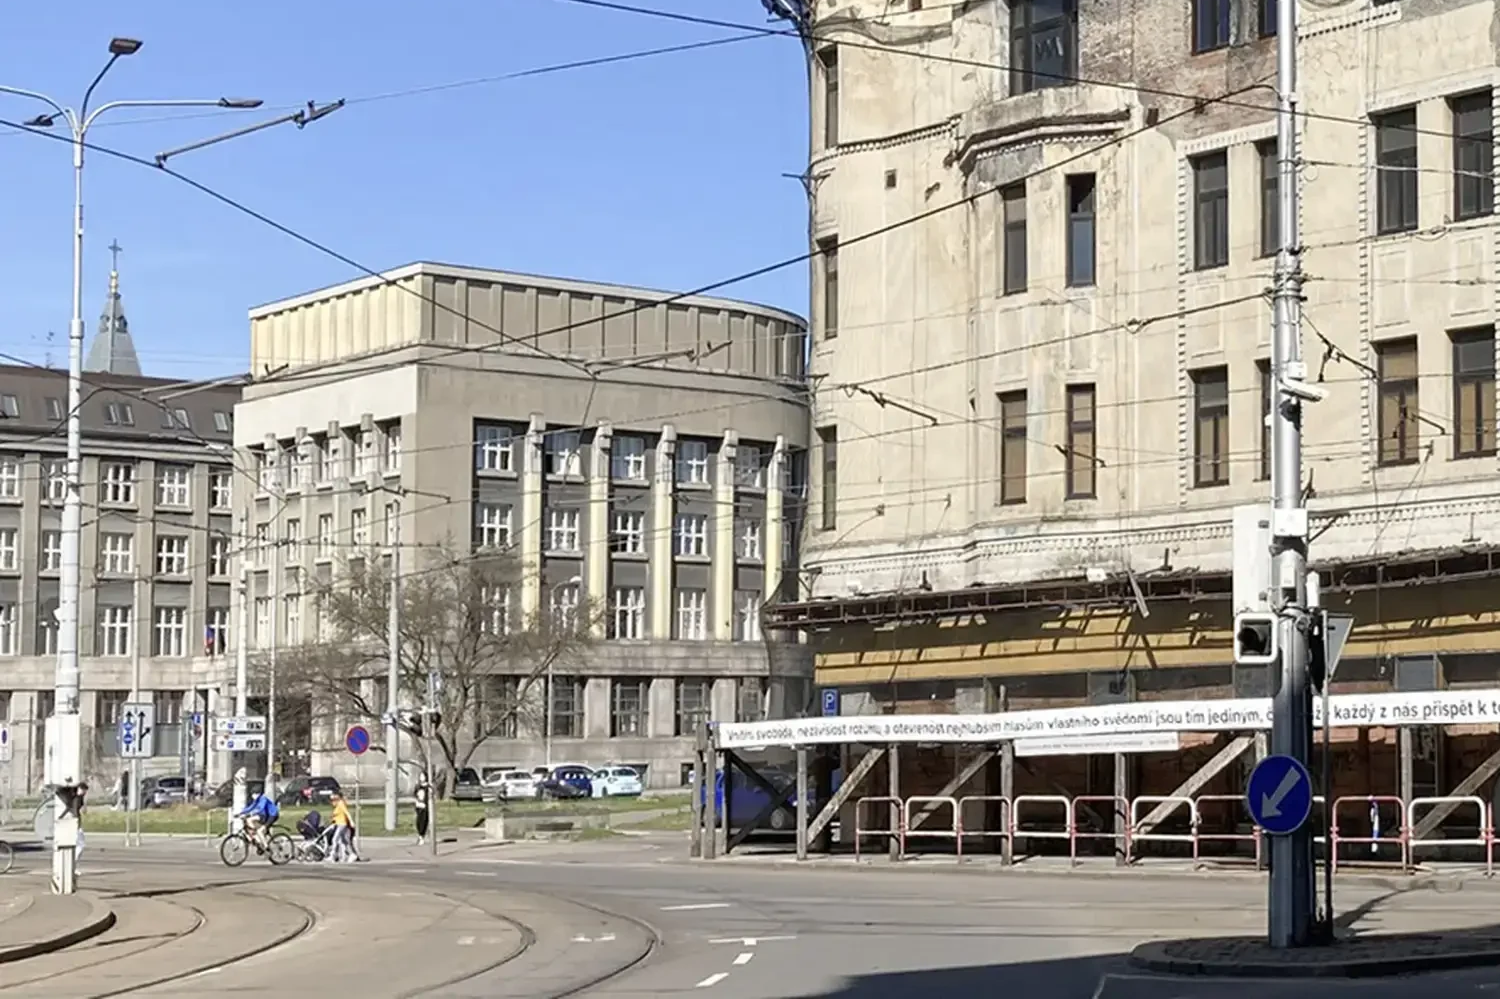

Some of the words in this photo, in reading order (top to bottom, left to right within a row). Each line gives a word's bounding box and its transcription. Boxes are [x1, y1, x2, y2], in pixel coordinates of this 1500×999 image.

[1155, 709, 1182, 727] jsou
[1185, 709, 1205, 724] tím
[1207, 706, 1263, 725] jediným,
[1333, 702, 1376, 722] každý
[1380, 706, 1387, 718] z
[1392, 702, 1418, 717] nás
[1422, 699, 1474, 719] přispět
[1478, 699, 1488, 715] k
